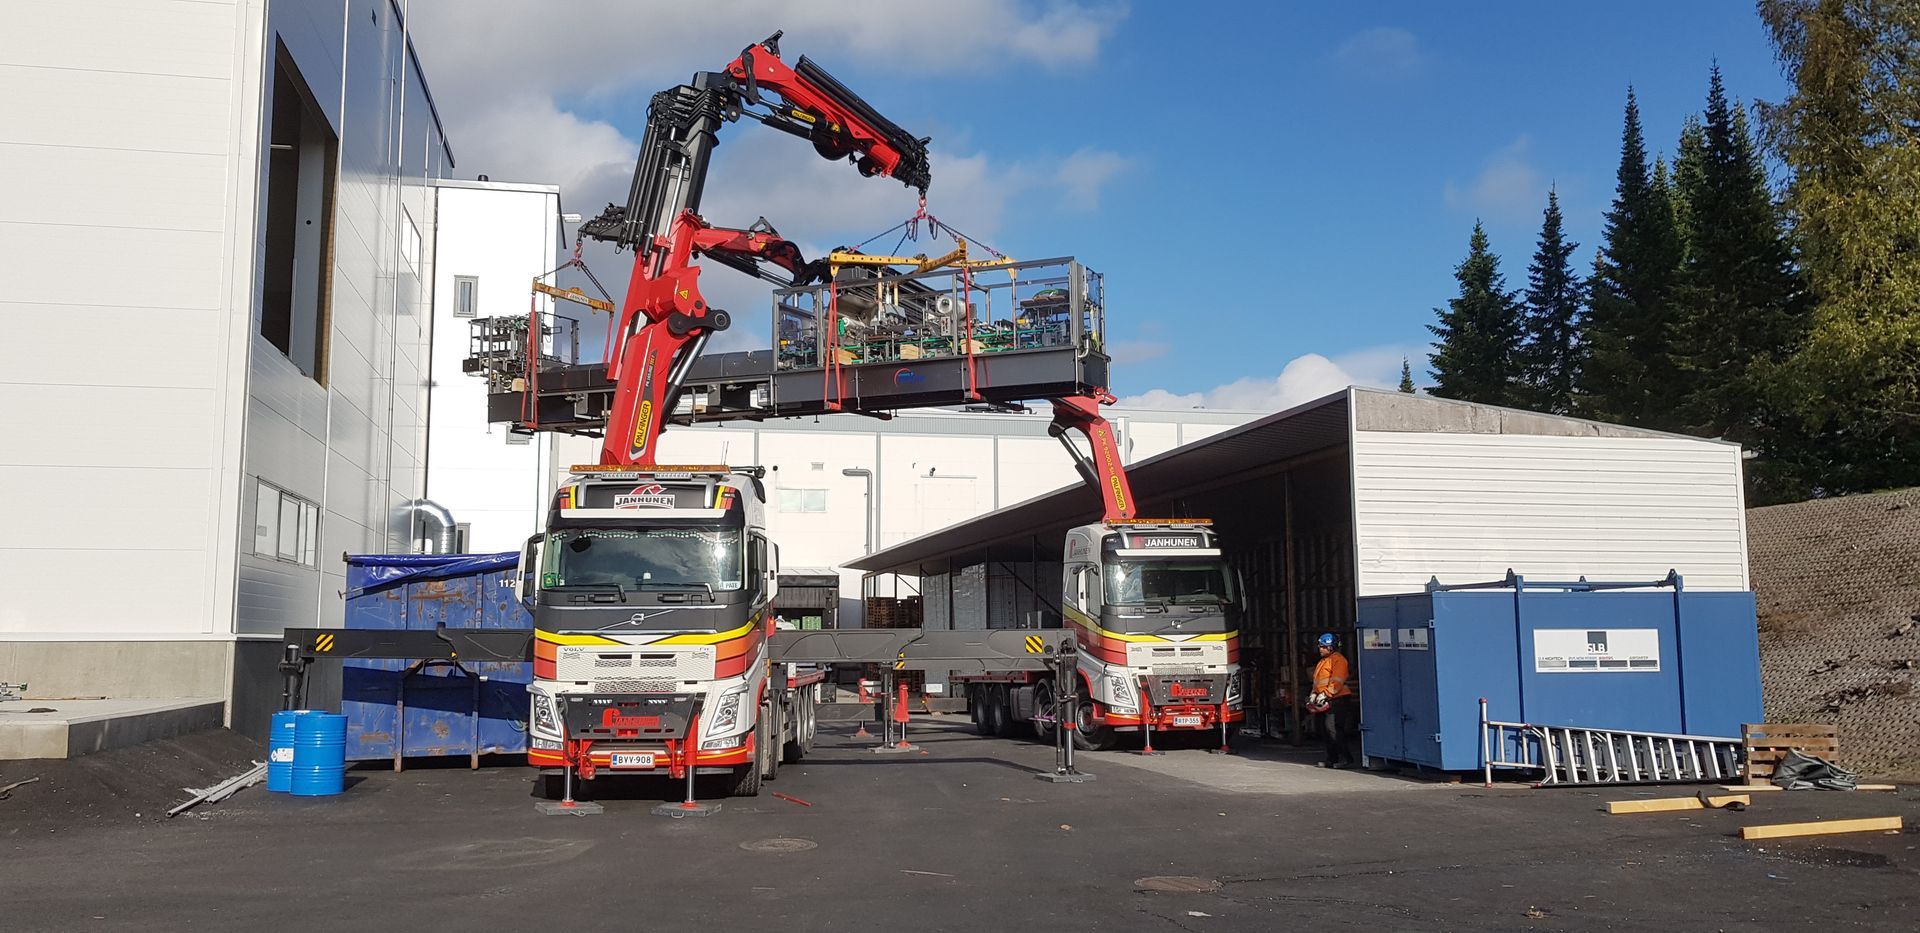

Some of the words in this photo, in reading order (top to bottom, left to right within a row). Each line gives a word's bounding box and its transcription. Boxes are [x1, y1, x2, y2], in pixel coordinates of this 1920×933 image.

[635, 403, 650, 444] PALFINGER
[1112, 477, 1125, 509] PALFINGER
[615, 497, 674, 506] JANHUNEN
[1145, 538, 1197, 547] JANHUNEN
[499, 579, 516, 588] 112
[618, 756, 651, 764] BVV-908
